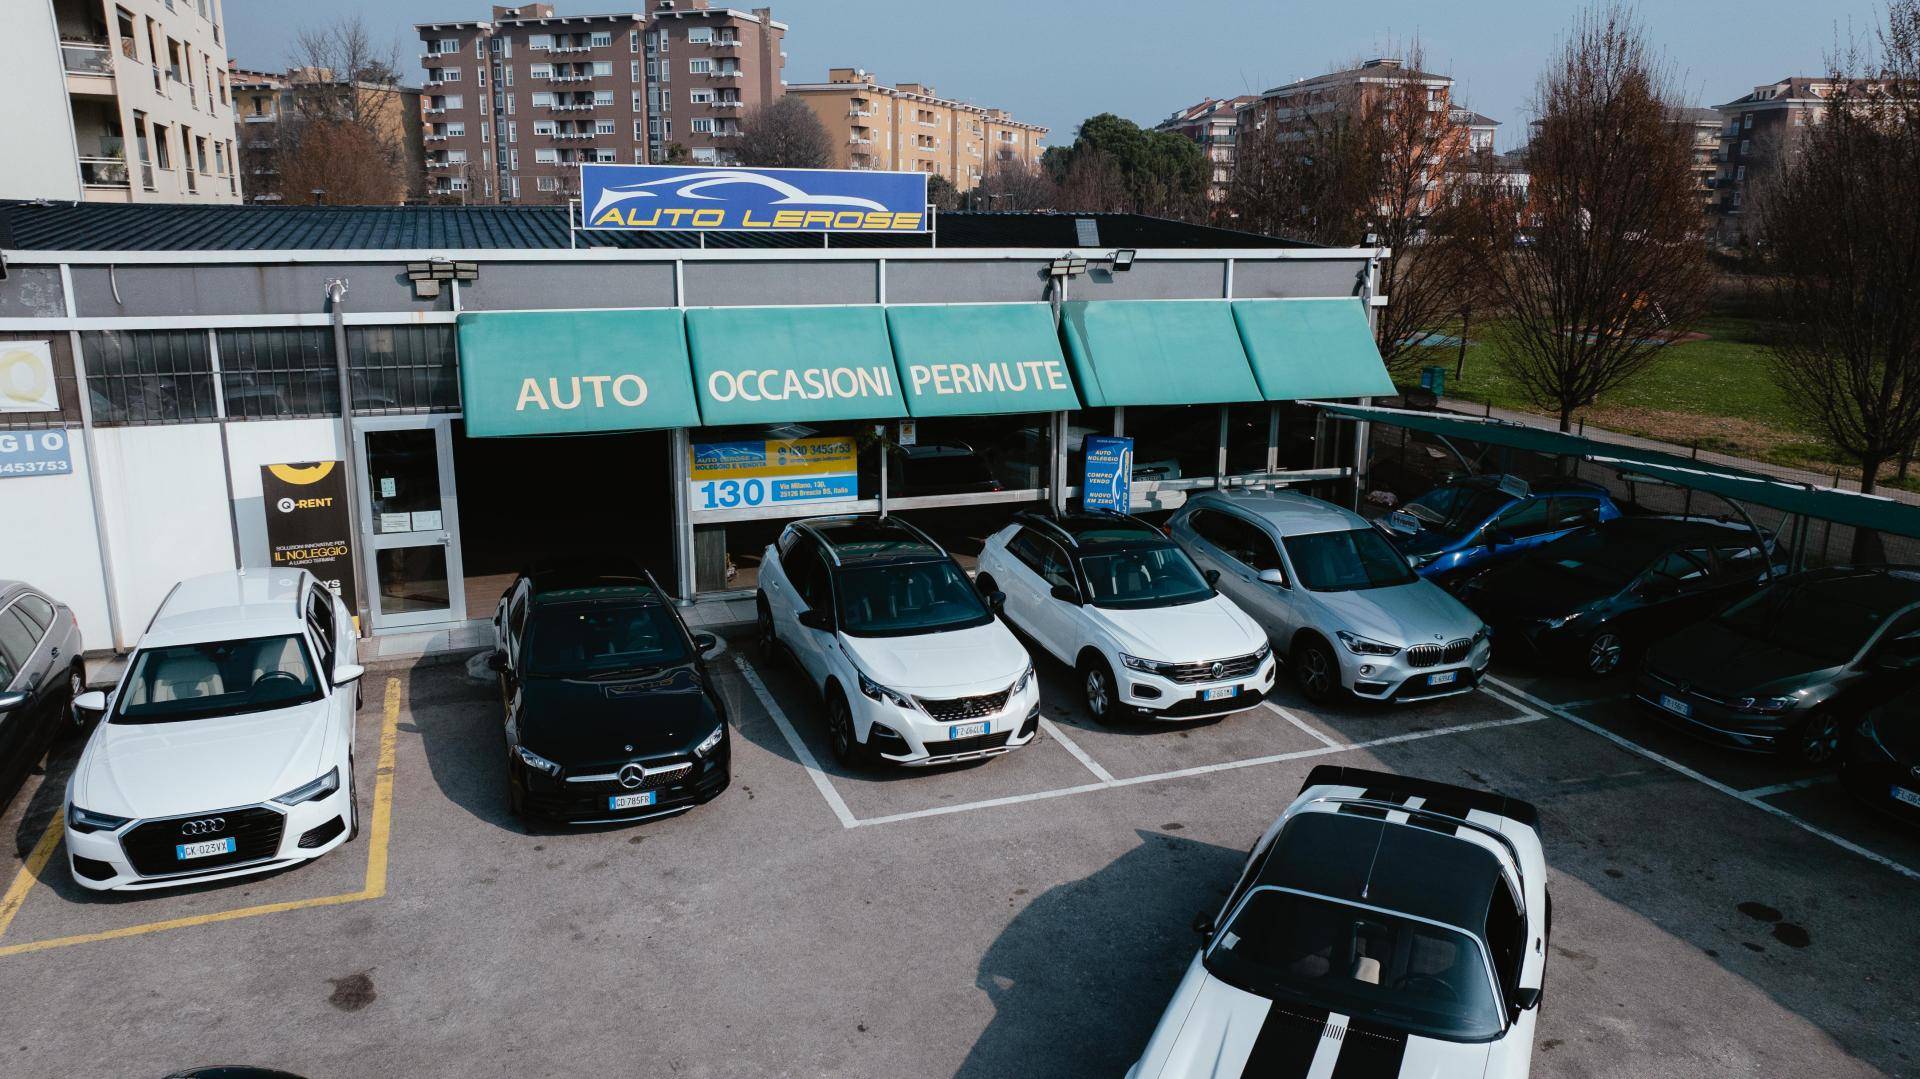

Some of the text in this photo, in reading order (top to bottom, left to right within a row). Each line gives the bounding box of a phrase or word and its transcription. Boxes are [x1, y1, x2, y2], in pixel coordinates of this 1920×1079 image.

[595, 208, 922, 229] AUTO LEROSE
[708, 366, 893, 402] OCCASIONI
[909, 360, 1067, 395] PERMUTE
[515, 374, 648, 411] AUTO
[0, 460, 68, 474] 453753
[701, 479, 765, 508] 130
[274, 546, 348, 562] IL NOLEGGIO
